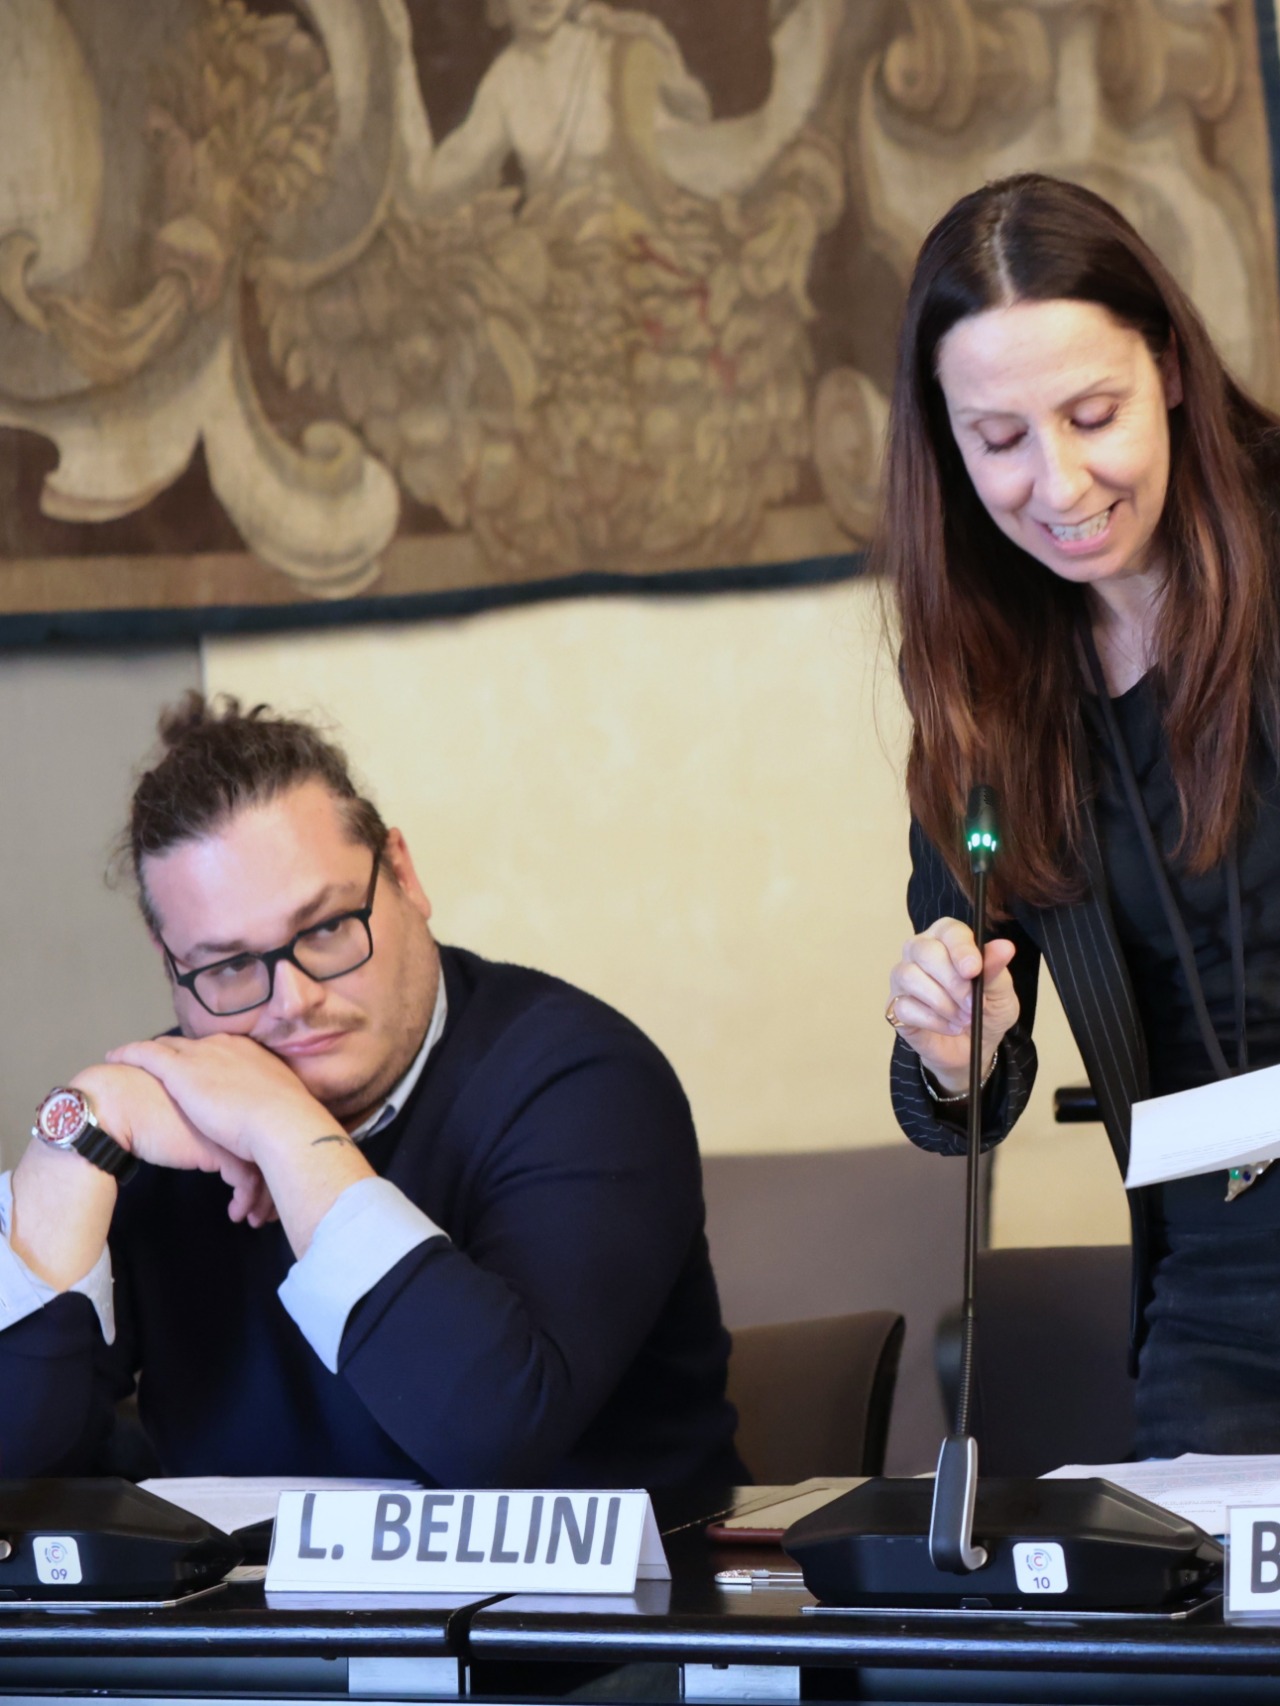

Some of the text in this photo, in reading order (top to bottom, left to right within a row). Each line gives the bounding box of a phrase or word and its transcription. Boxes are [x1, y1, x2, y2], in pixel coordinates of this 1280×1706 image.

[298, 1492, 621, 1565] L. BELLINI
[50, 1568, 68, 1581] 09
[1033, 1576, 1051, 1590] 10
